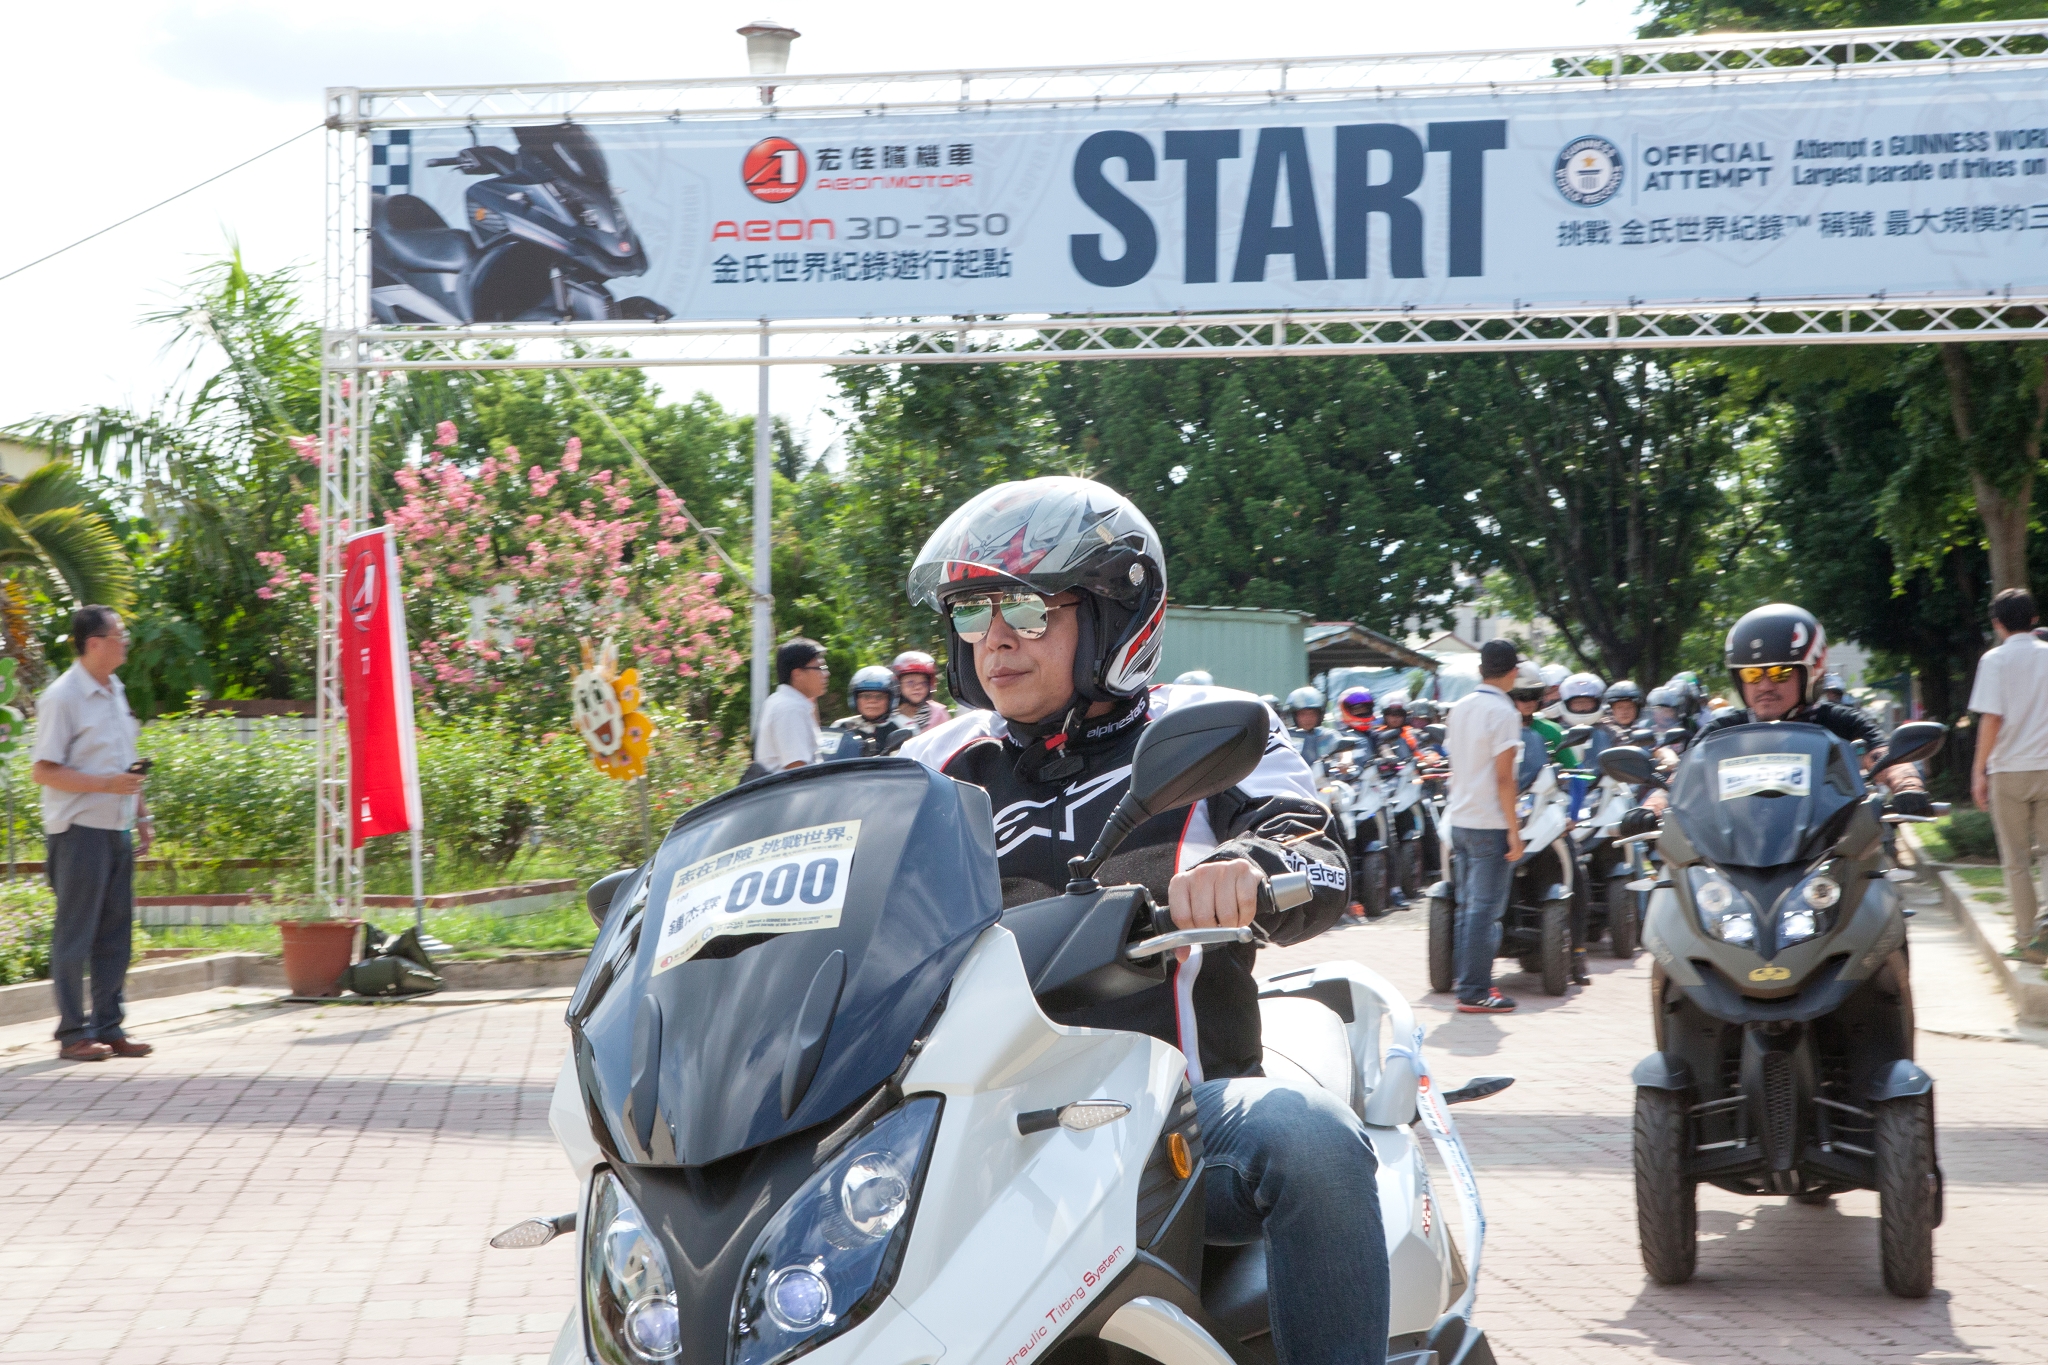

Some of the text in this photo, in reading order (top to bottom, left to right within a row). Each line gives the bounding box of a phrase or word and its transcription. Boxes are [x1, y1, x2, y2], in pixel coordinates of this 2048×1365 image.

[1643, 141, 1773, 167] OFFICIAL
[1793, 138, 1867, 160] Attempt
[1871, 139, 1884, 157] a
[1889, 131, 1989, 156] GUINNESS
[1642, 166, 1773, 192] ATTEMPT
[1792, 157, 2047, 187] Largest parade of trikes on
[1069, 119, 1508, 287] START
[845, 213, 1011, 241] 3D-350
[1556, 219, 1613, 247] 挑戰
[1818, 209, 1876, 239] 稱號
[710, 246, 1014, 285] 金氏世界紀錄遊行起點
[1086, 696, 1147, 738] alpinestars
[676, 846, 755, 888] 志在冒險
[724, 857, 839, 914] 000
[1083, 1245, 1125, 1287] System
[1045, 1286, 1086, 1324] Tilting
